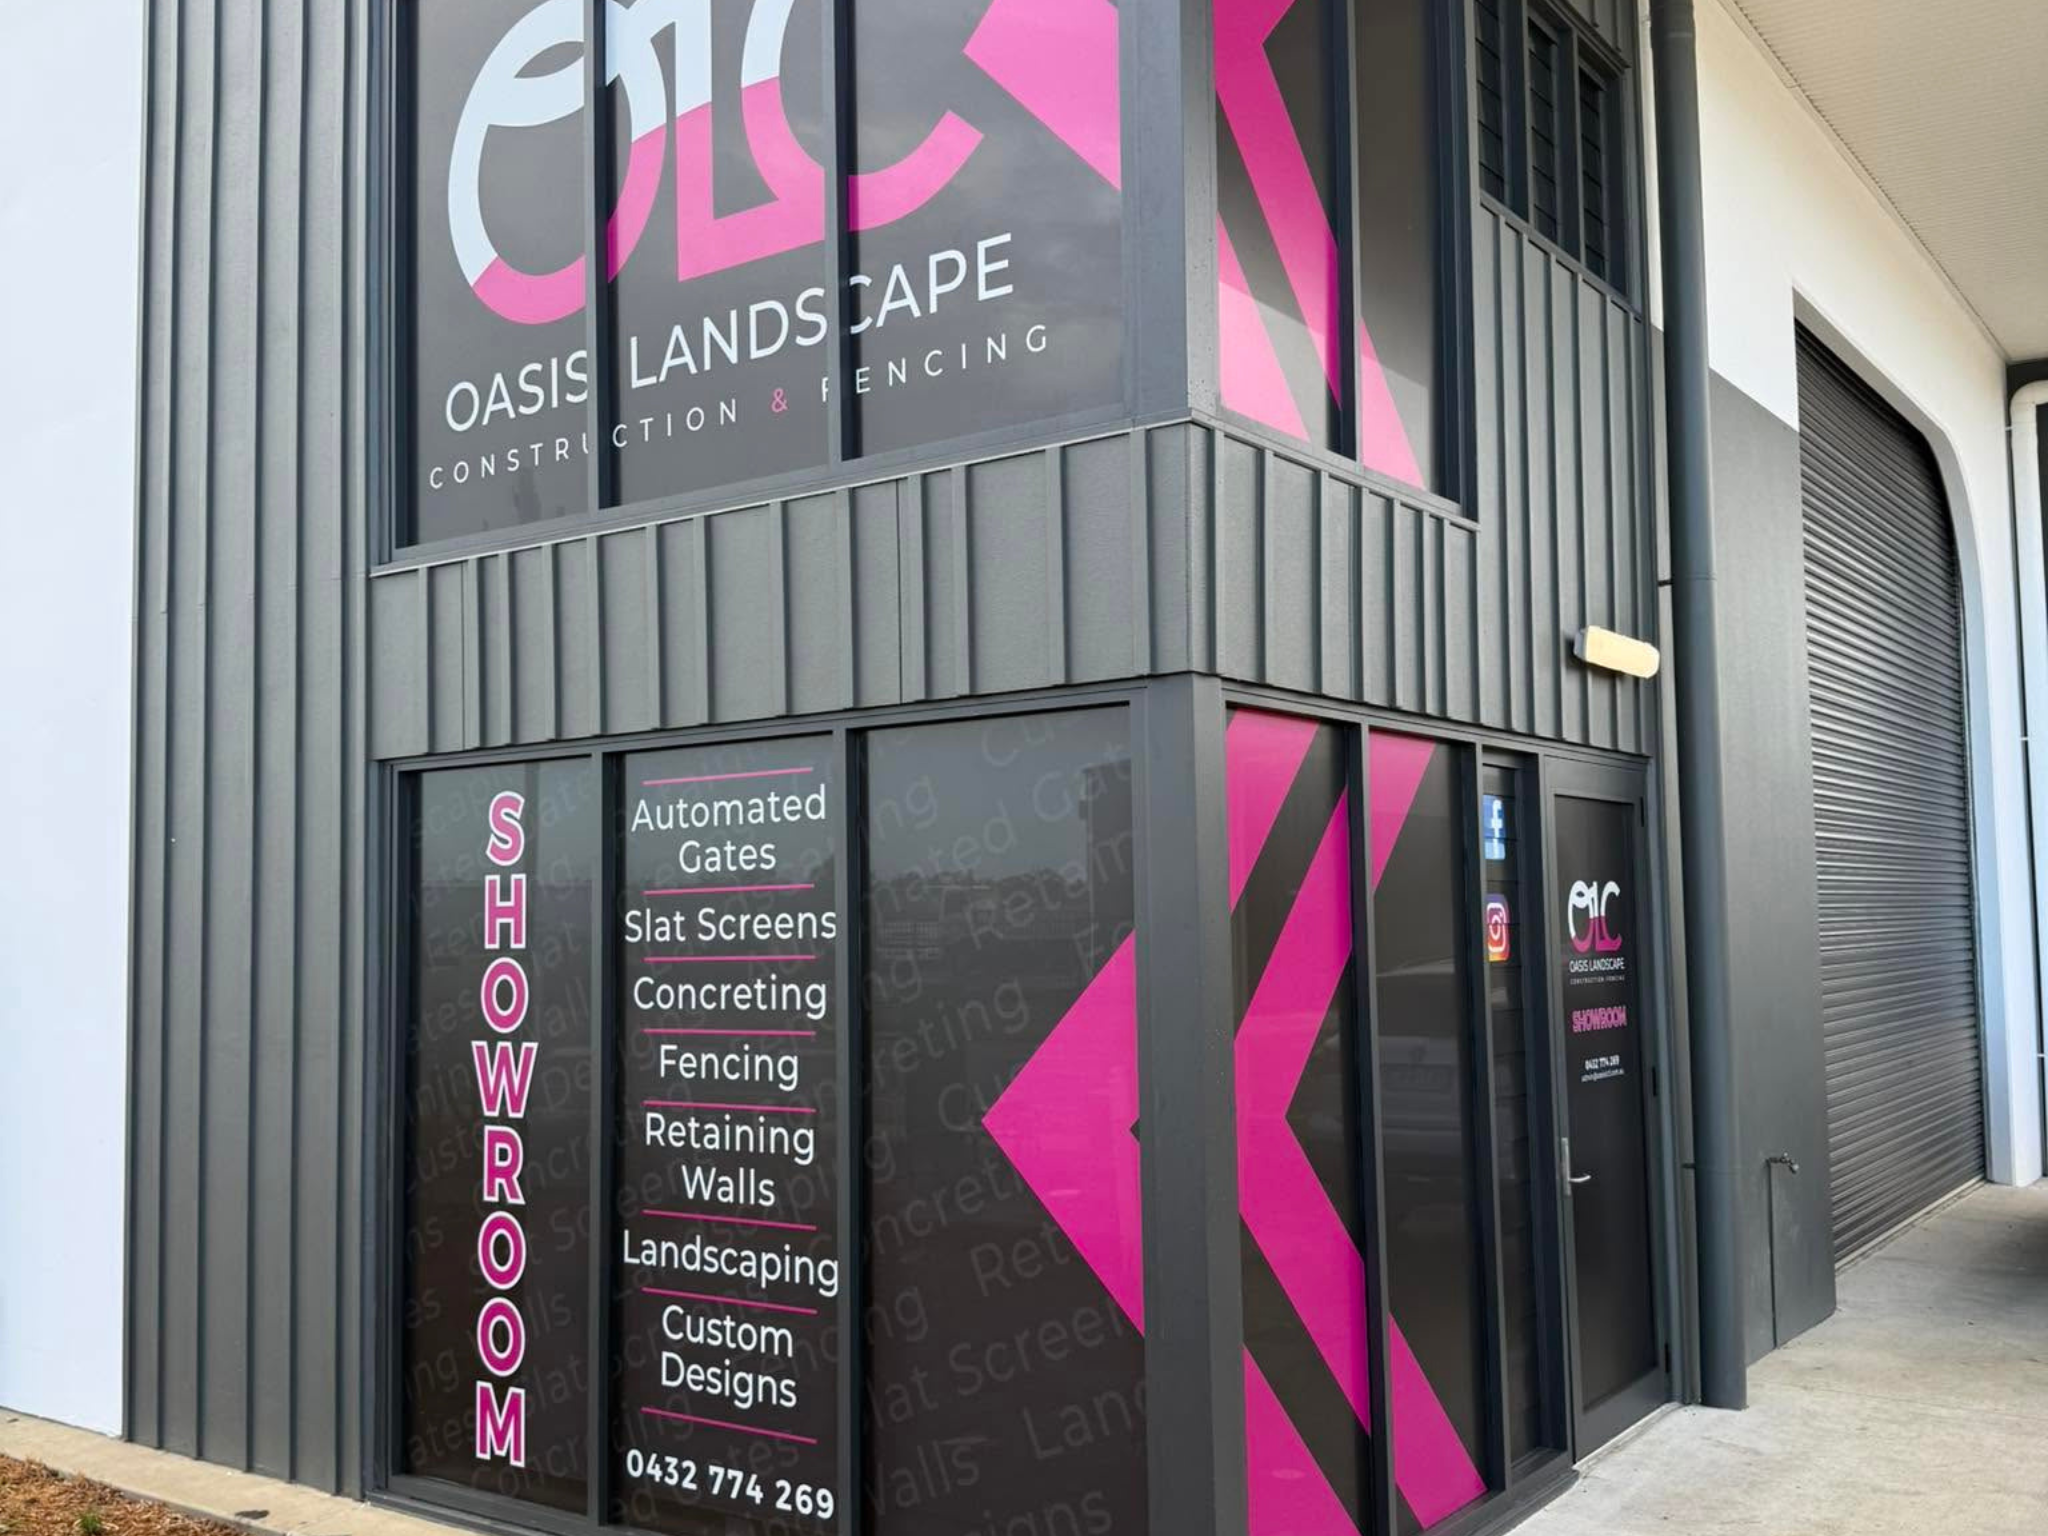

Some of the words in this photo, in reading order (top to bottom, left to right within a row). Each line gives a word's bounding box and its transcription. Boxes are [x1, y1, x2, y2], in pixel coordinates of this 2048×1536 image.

[445, 350, 588, 432] OASIS
[630, 232, 1014, 389] LANDSCAPE
[771, 388, 788, 413] &
[631, 783, 826, 832] Automated
[679, 840, 776, 874] Gates
[625, 908, 686, 943] Slat
[698, 907, 837, 941] Screens
[633, 973, 827, 1020] Concreting
[660, 1043, 798, 1092] Fencing
[471, 790, 539, 1468] SHOWROOM
[646, 1112, 815, 1166] Retaining
[682, 1164, 776, 1207] Walls
[624, 1230, 839, 1297] Landscaping
[661, 1304, 794, 1358] Custom
[661, 1351, 797, 1410] Designs
[626, 1449, 699, 1490] 0432
[708, 1465, 764, 1504] 774
[775, 1479, 835, 1519] 269
